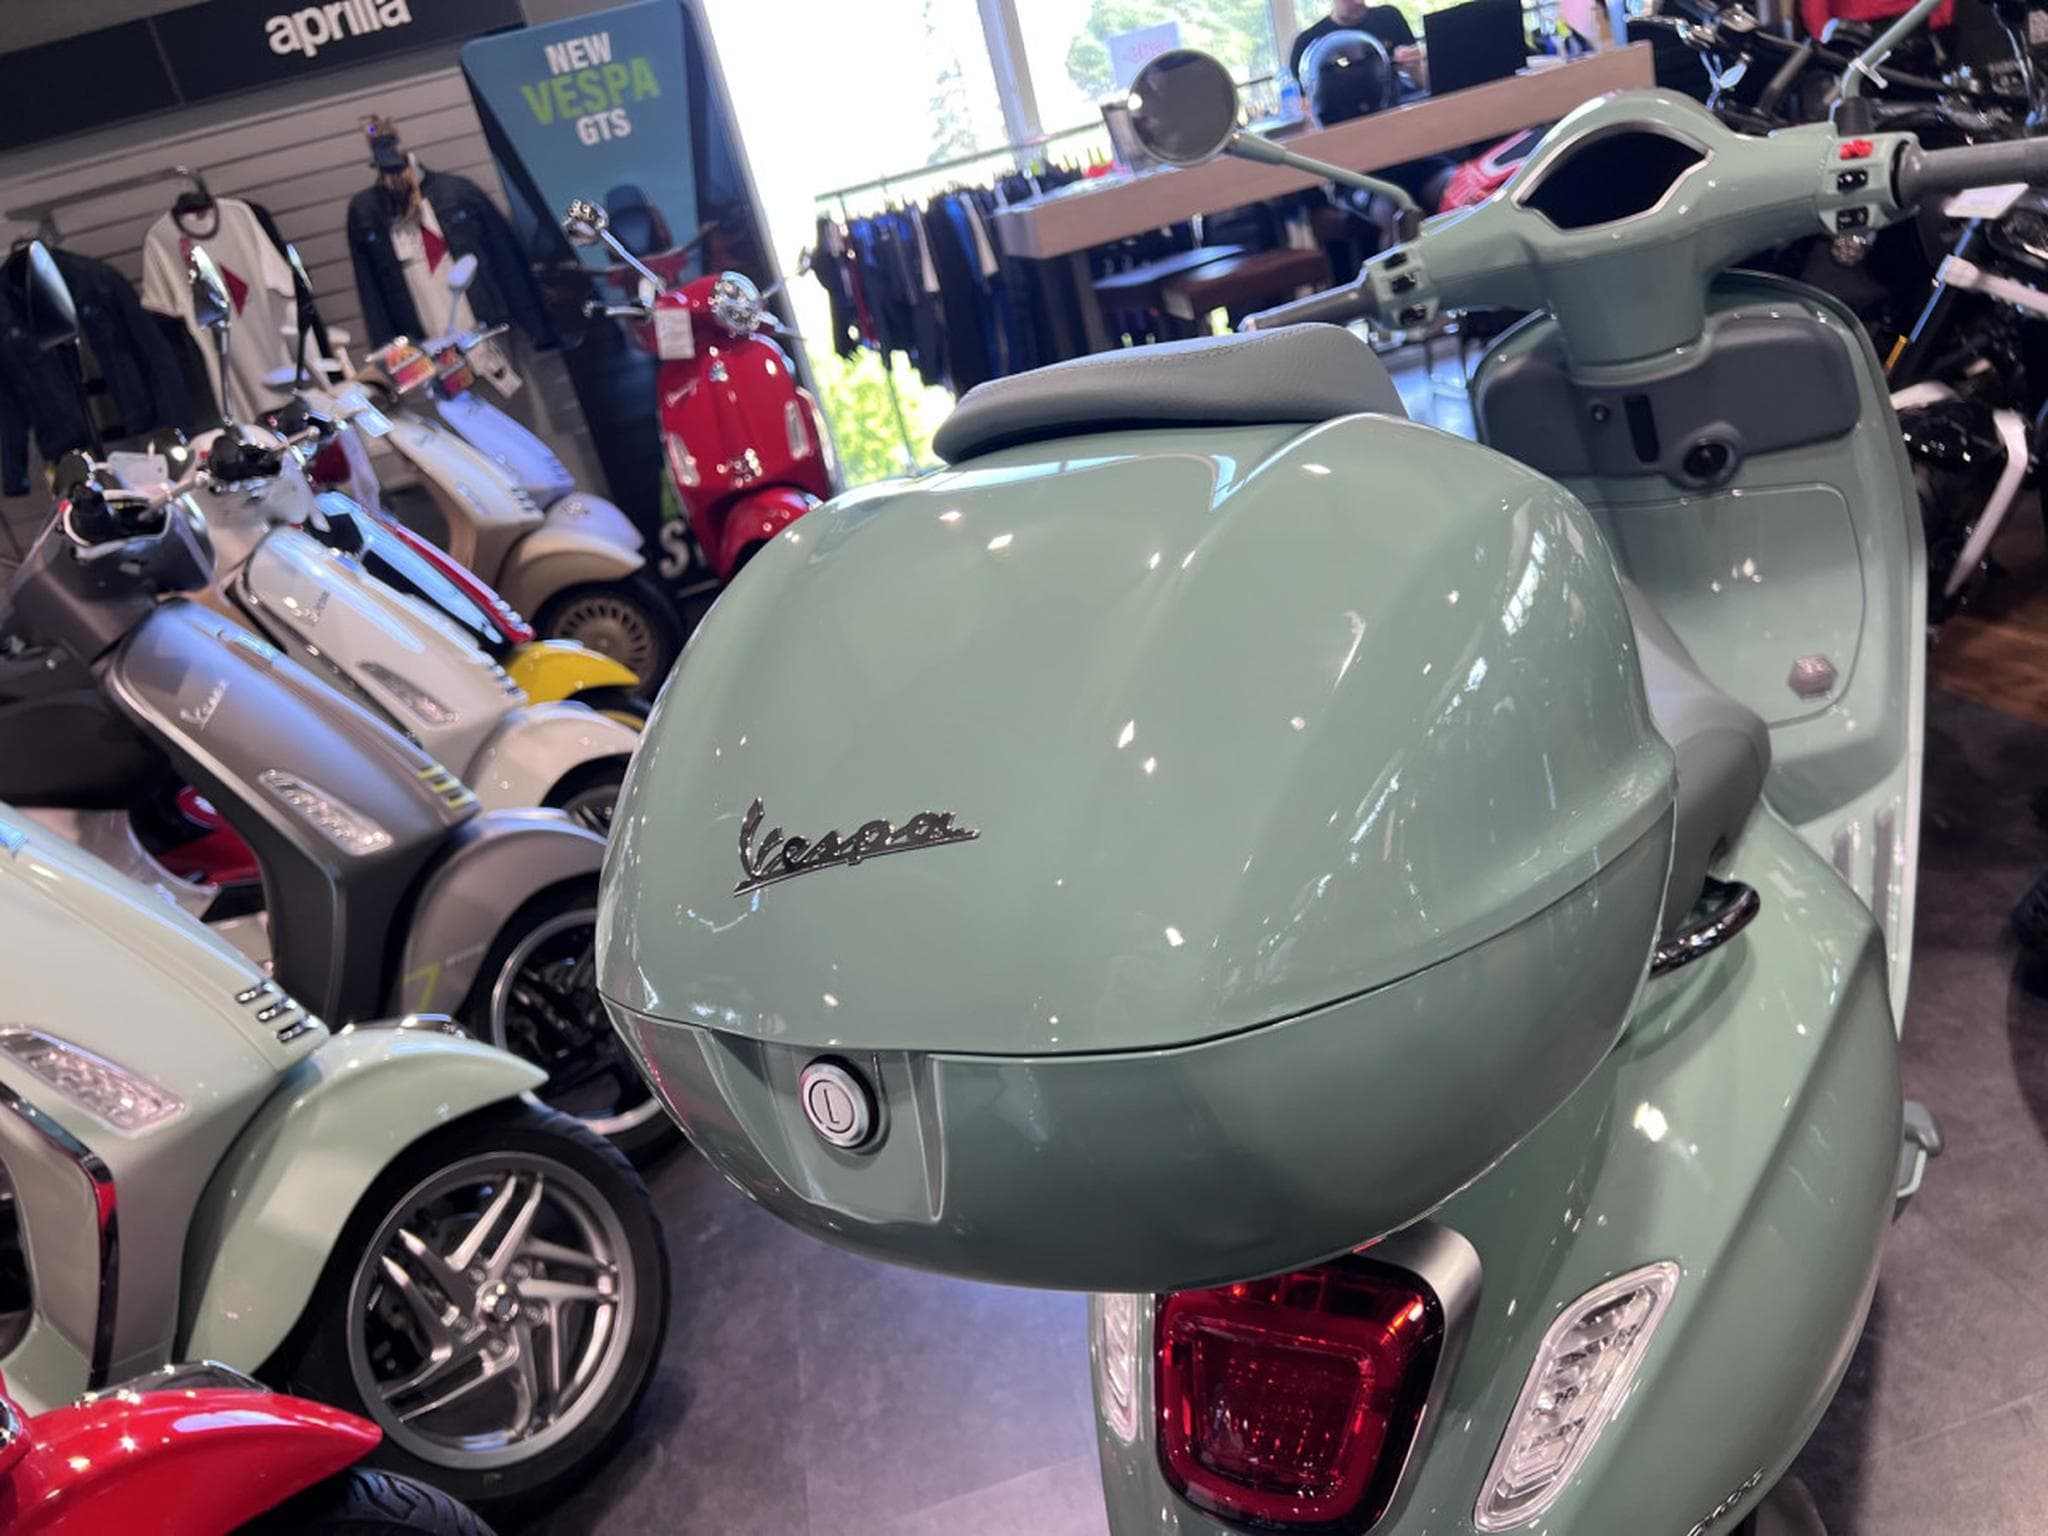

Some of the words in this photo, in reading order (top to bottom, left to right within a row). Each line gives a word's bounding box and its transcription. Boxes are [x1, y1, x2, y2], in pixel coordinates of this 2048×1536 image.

[265, 0, 412, 57] aprilia
[544, 32, 612, 75] NEW
[520, 56, 661, 126] VESPA
[576, 107, 631, 145] GTS
[733, 797, 980, 898] Vespa
